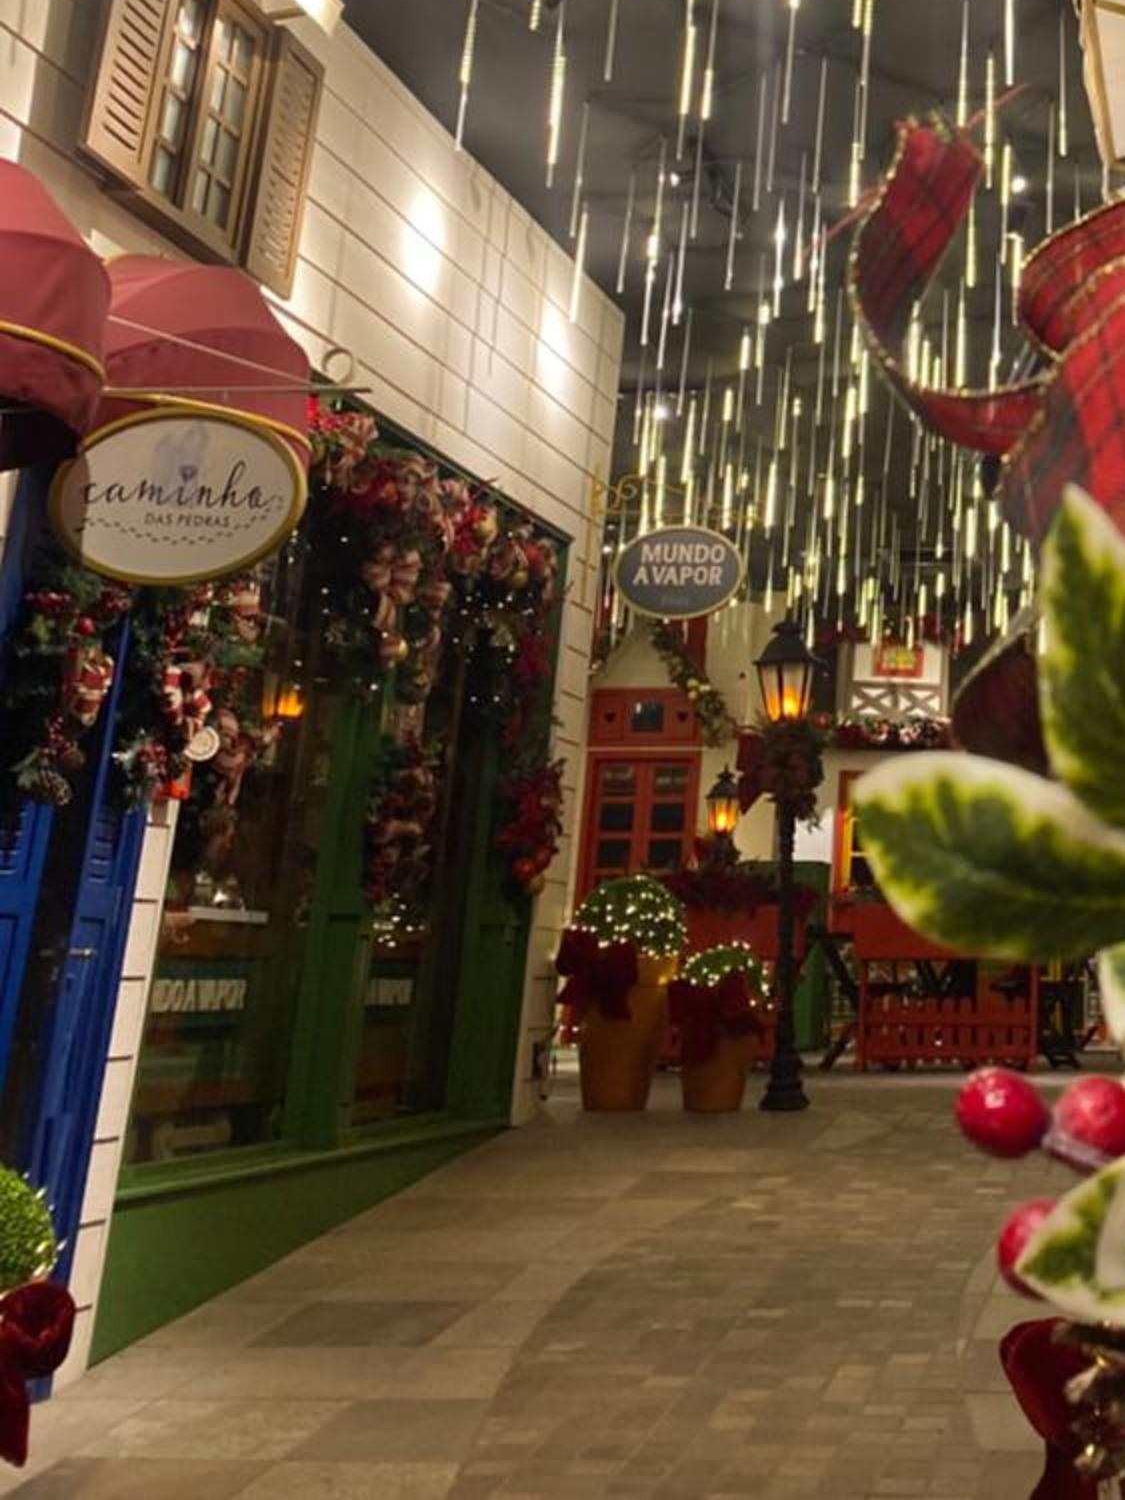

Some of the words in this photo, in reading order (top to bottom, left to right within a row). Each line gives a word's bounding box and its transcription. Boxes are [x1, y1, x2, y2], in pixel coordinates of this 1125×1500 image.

[83, 460, 268, 509] caminho
[145, 512, 173, 527] DAS
[176, 513, 231, 528] PEDRAS
[640, 543, 727, 563] MUNDO
[632, 565, 649, 586] A
[651, 565, 724, 586] VAPOR
